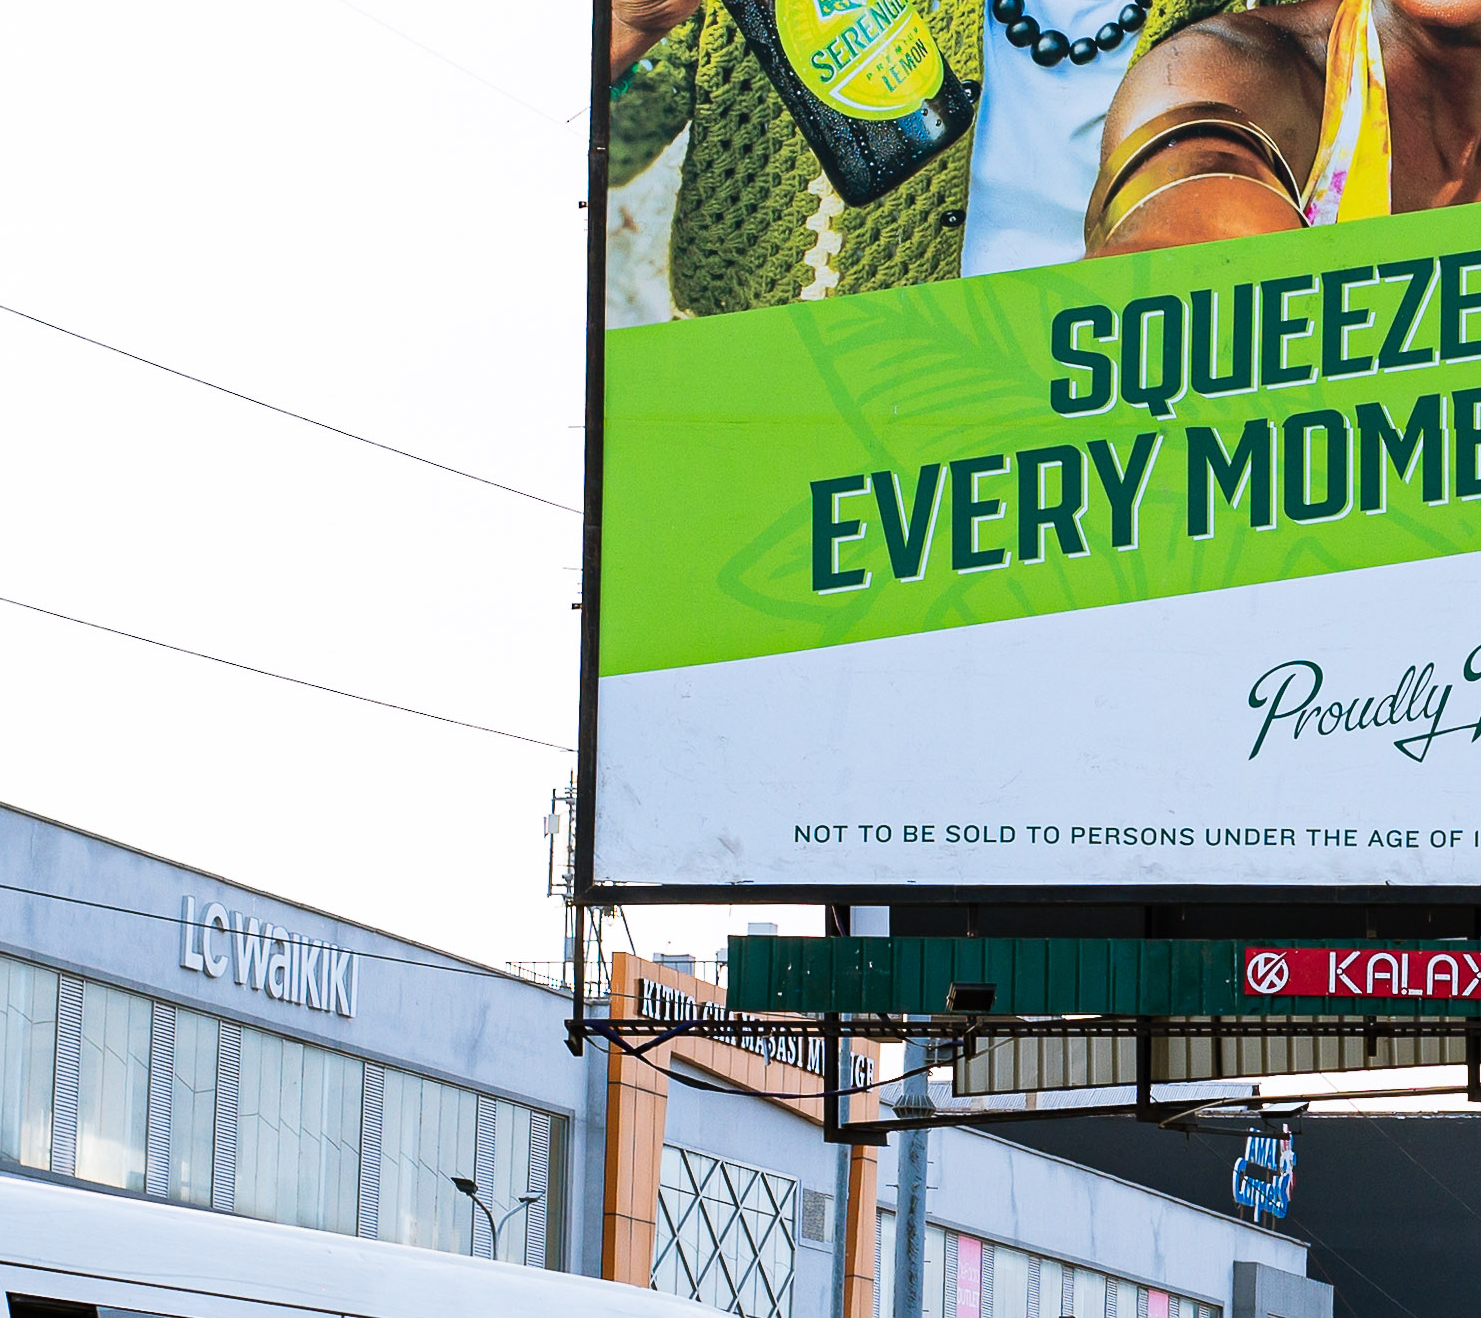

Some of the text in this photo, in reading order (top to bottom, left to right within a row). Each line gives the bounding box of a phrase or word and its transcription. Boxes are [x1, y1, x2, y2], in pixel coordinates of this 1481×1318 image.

[880, 37, 930, 93] LEMON
[809, 431, 1164, 596] EVERY
[1248, 659, 1453, 762] Proudly
[794, 824, 849, 843] NOT
[857, 824, 892, 843] TO
[903, 825, 935, 843] BE
[945, 824, 1016, 844] SOLD
[1026, 825, 1060, 845] TO
[1071, 826, 1195, 846] PERSONS
[1205, 828, 1296, 847] UNDER
[1305, 828, 1358, 847] THE
[1367, 829, 1420, 848] AGE
[1430, 829, 1464, 848] OF
[179, 894, 231, 979] LC
[636, 977, 699, 1023] KITUO
